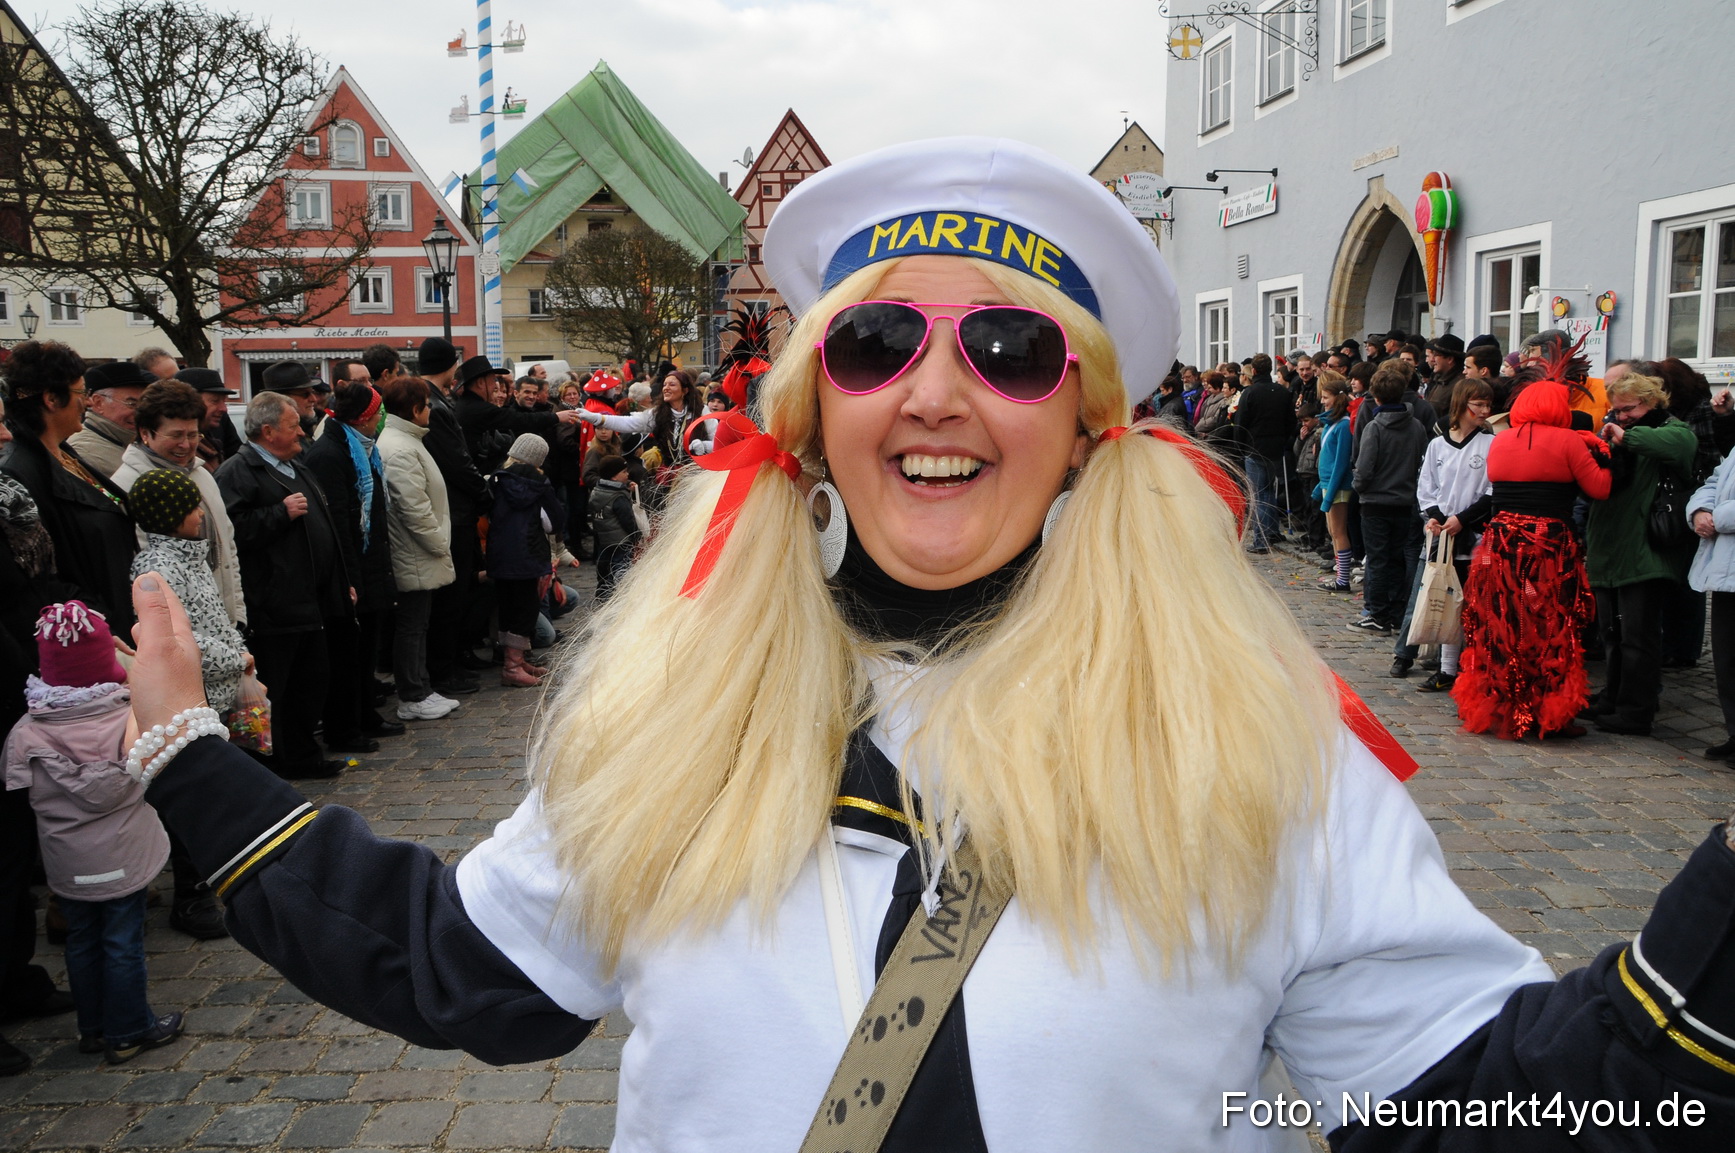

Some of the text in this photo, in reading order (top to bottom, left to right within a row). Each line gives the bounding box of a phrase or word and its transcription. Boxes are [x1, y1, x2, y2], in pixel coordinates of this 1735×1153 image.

[1228, 202, 1265, 222] Bella Roma
[867, 212, 1063, 287] MARINE
[314, 327, 389, 337] Riebe Moden
[1574, 320, 1592, 333] Eis
